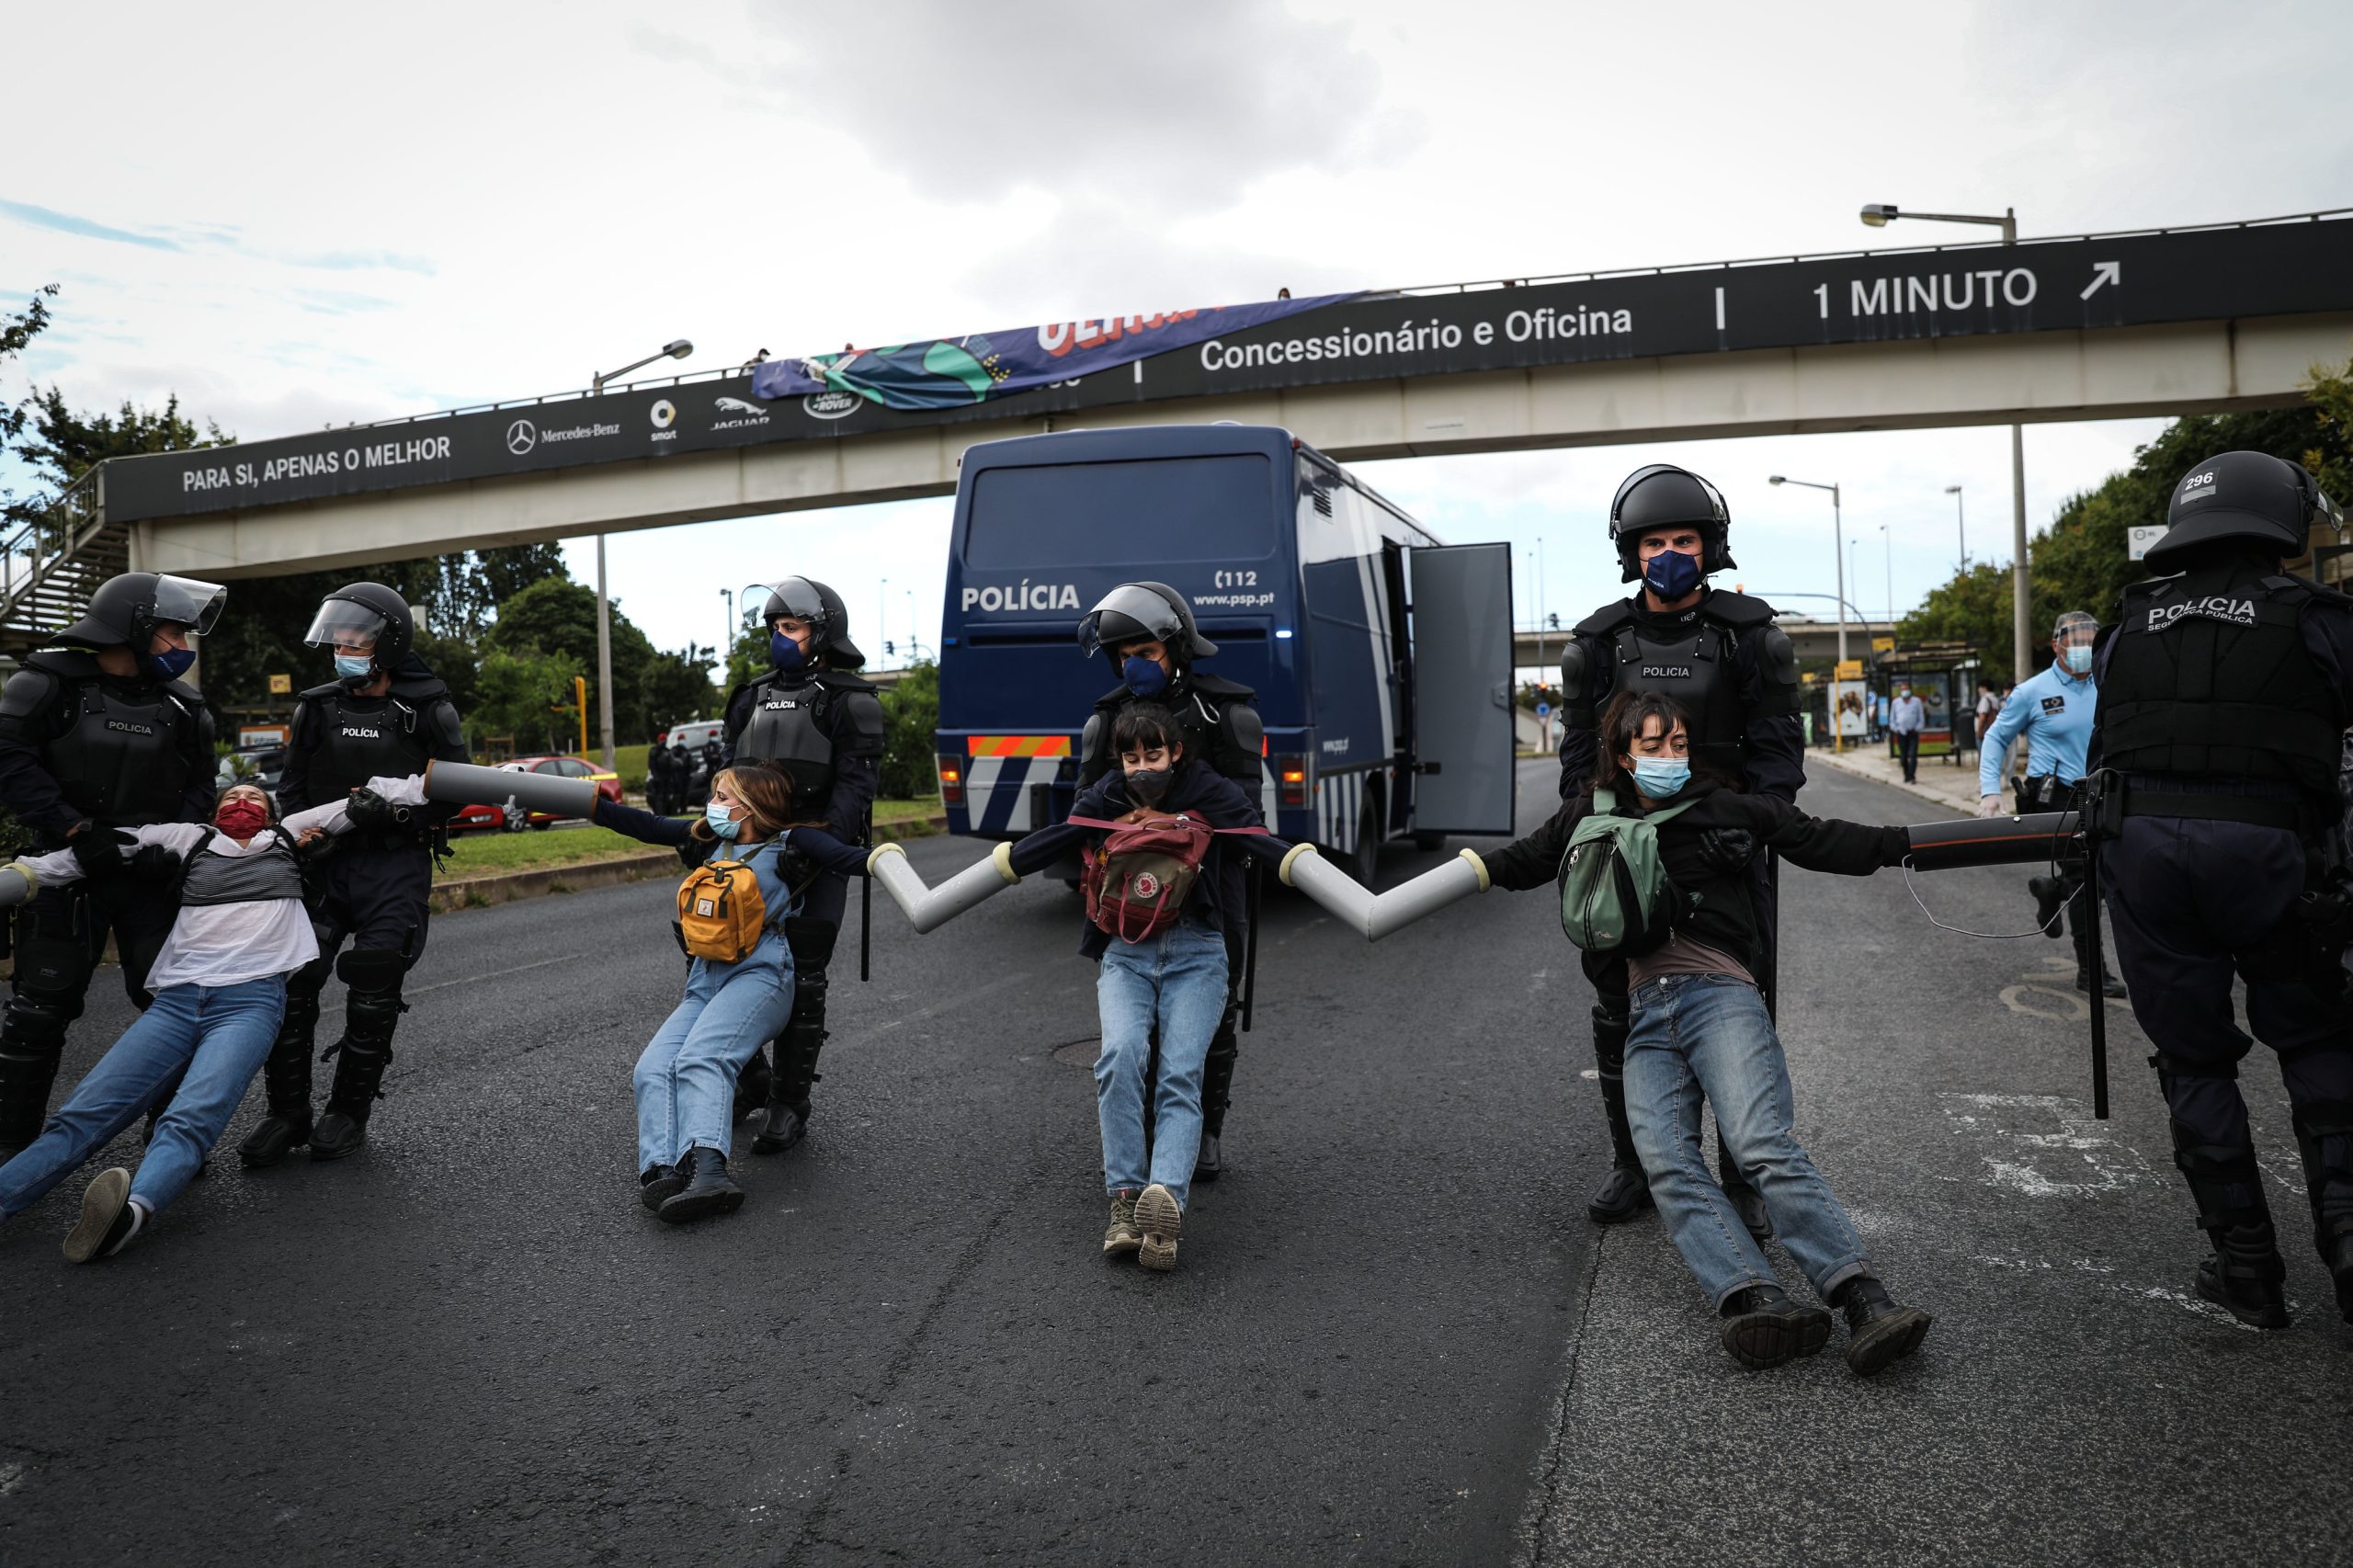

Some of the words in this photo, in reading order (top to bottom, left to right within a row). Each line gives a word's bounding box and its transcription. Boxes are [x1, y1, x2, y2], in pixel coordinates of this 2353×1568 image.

[1813, 282, 1828, 319] 1
[1850, 267, 2038, 317] MINUTO
[1199, 318, 1461, 371] Concessionário
[1472, 321, 1495, 346] e
[1505, 304, 1632, 343] Oficina
[818, 397, 853, 411] ROVER
[707, 416, 770, 431] JAGUAR
[541, 423, 621, 443] Mercedes-Benz
[651, 429, 677, 442] smart
[183, 466, 231, 492] PARA
[234, 462, 258, 489] SI,
[263, 450, 339, 482] APENAS
[344, 448, 360, 471] O
[365, 436, 451, 468] MELHOR
[2185, 472, 2213, 491] 296
[961, 578, 1081, 612] POLÍCIA
[1193, 592, 1275, 608] www.psp.pt
[2148, 597, 2256, 625] POLÍCIA
[2205, 609, 2253, 625] PÚBLICA
[1643, 667, 1689, 677] POLICIA
[766, 699, 795, 710] POLÍCIA
[108, 721, 153, 734] POLICIA
[342, 727, 380, 738] POLÍCIA
